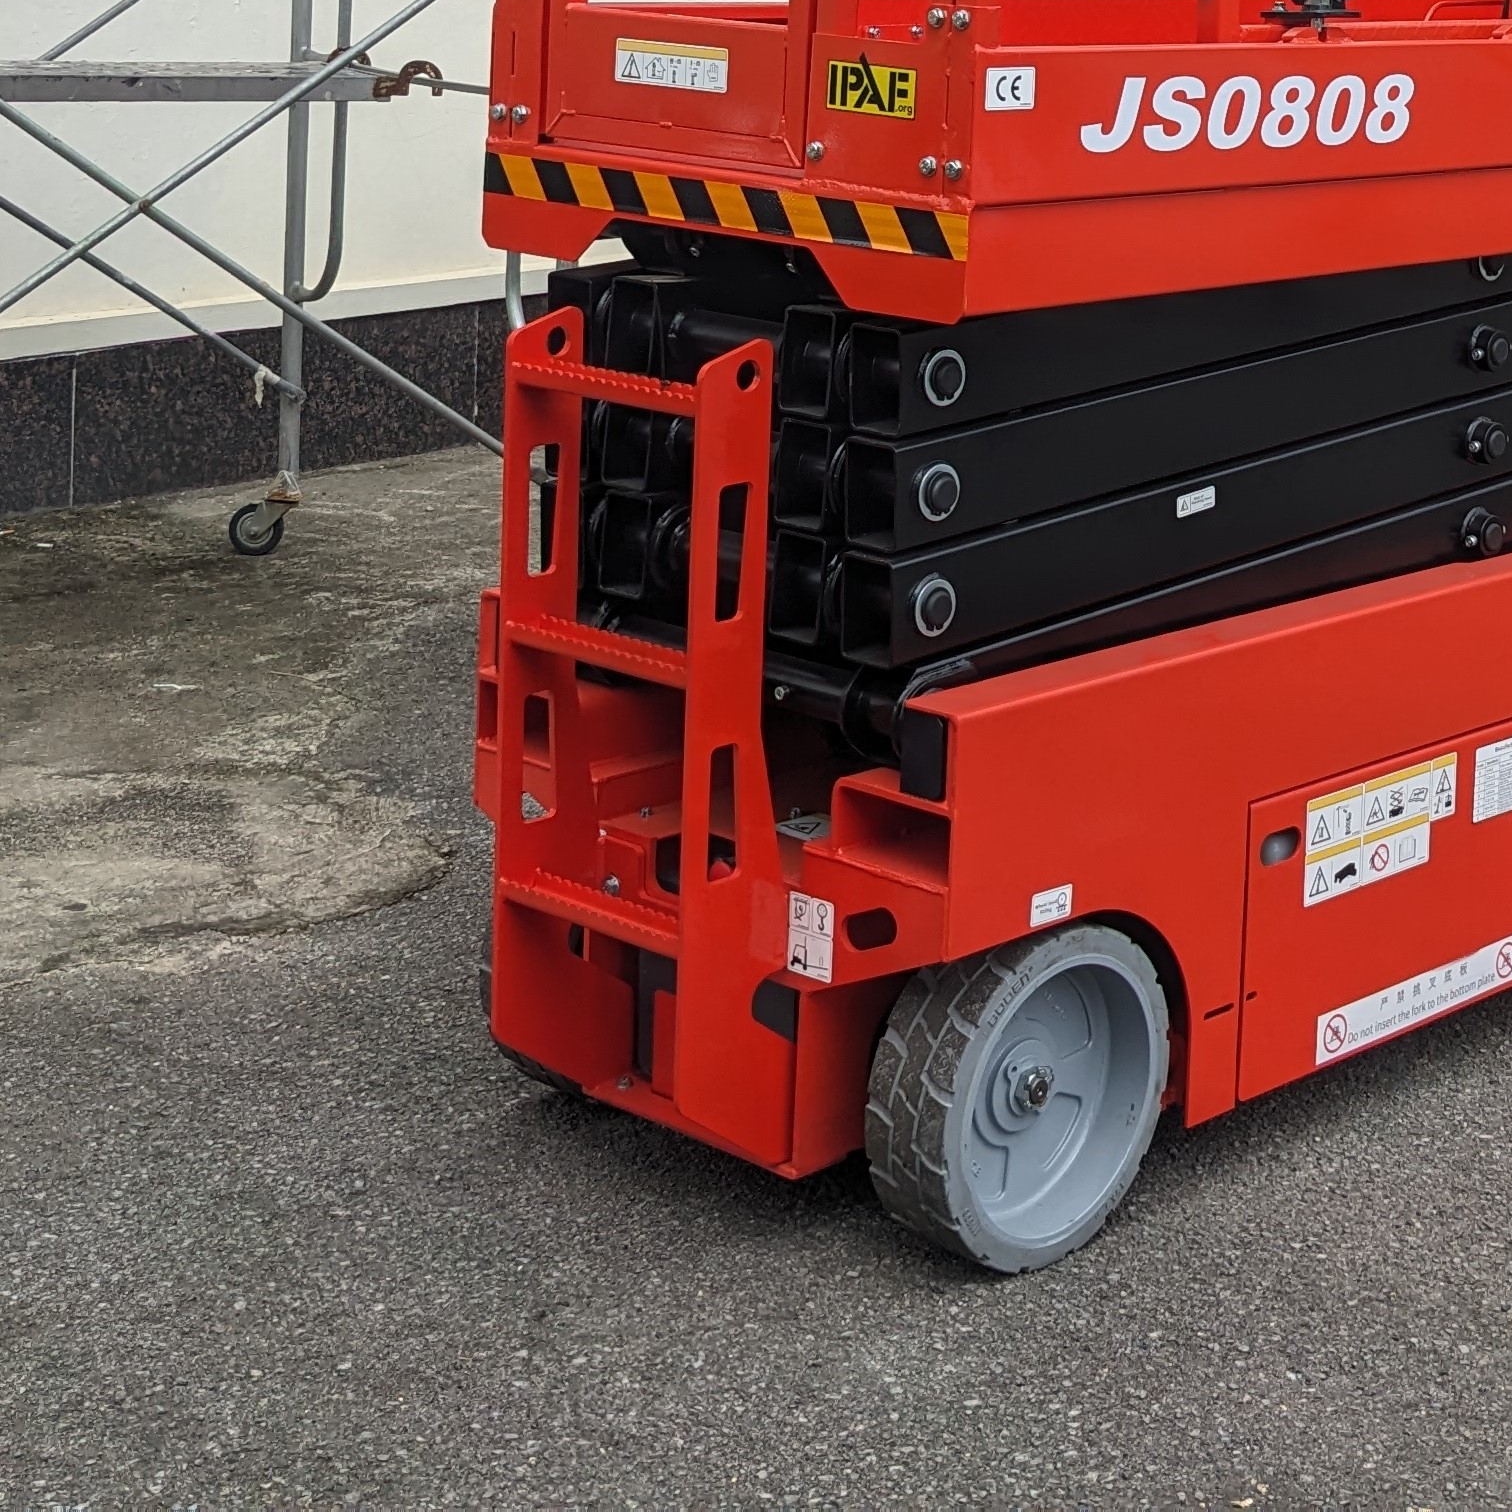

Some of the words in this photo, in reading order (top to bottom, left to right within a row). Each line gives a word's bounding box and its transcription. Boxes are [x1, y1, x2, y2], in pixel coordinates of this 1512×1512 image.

[829, 52, 910, 114] IPAF
[995, 74, 1022, 102] CE
[1080, 73, 1415, 154] JS0808
[1348, 1032, 1359, 1044] Do
[1360, 1024, 1373, 1037] not
[1375, 1015, 1397, 1032] insert
[1398, 1010, 1410, 1023] the
[1412, 1001, 1426, 1016] fork
[1428, 999, 1436, 1010] to
[1437, 993, 1449, 1006] the
[1450, 981, 1477, 999] bottom
[1477, 973, 1496, 990] plate
